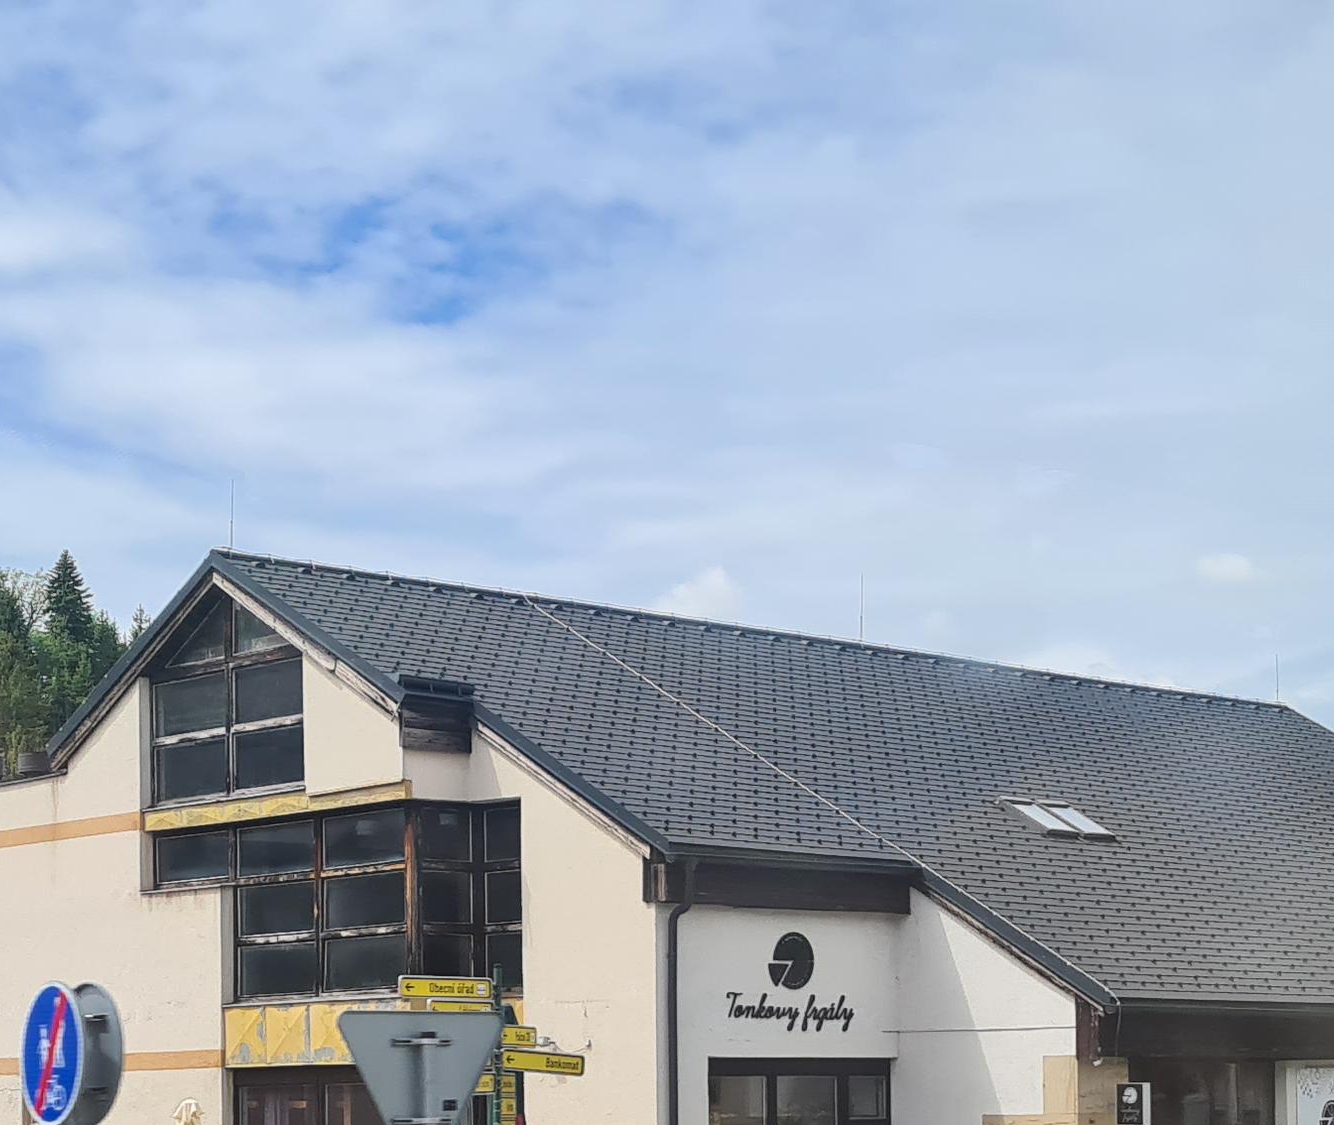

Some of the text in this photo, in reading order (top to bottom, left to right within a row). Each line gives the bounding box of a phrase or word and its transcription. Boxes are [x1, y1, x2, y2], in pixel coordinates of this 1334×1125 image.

[725, 991, 855, 1033] Tonkovy frgály
[545, 1056, 580, 1071] Bankomat
